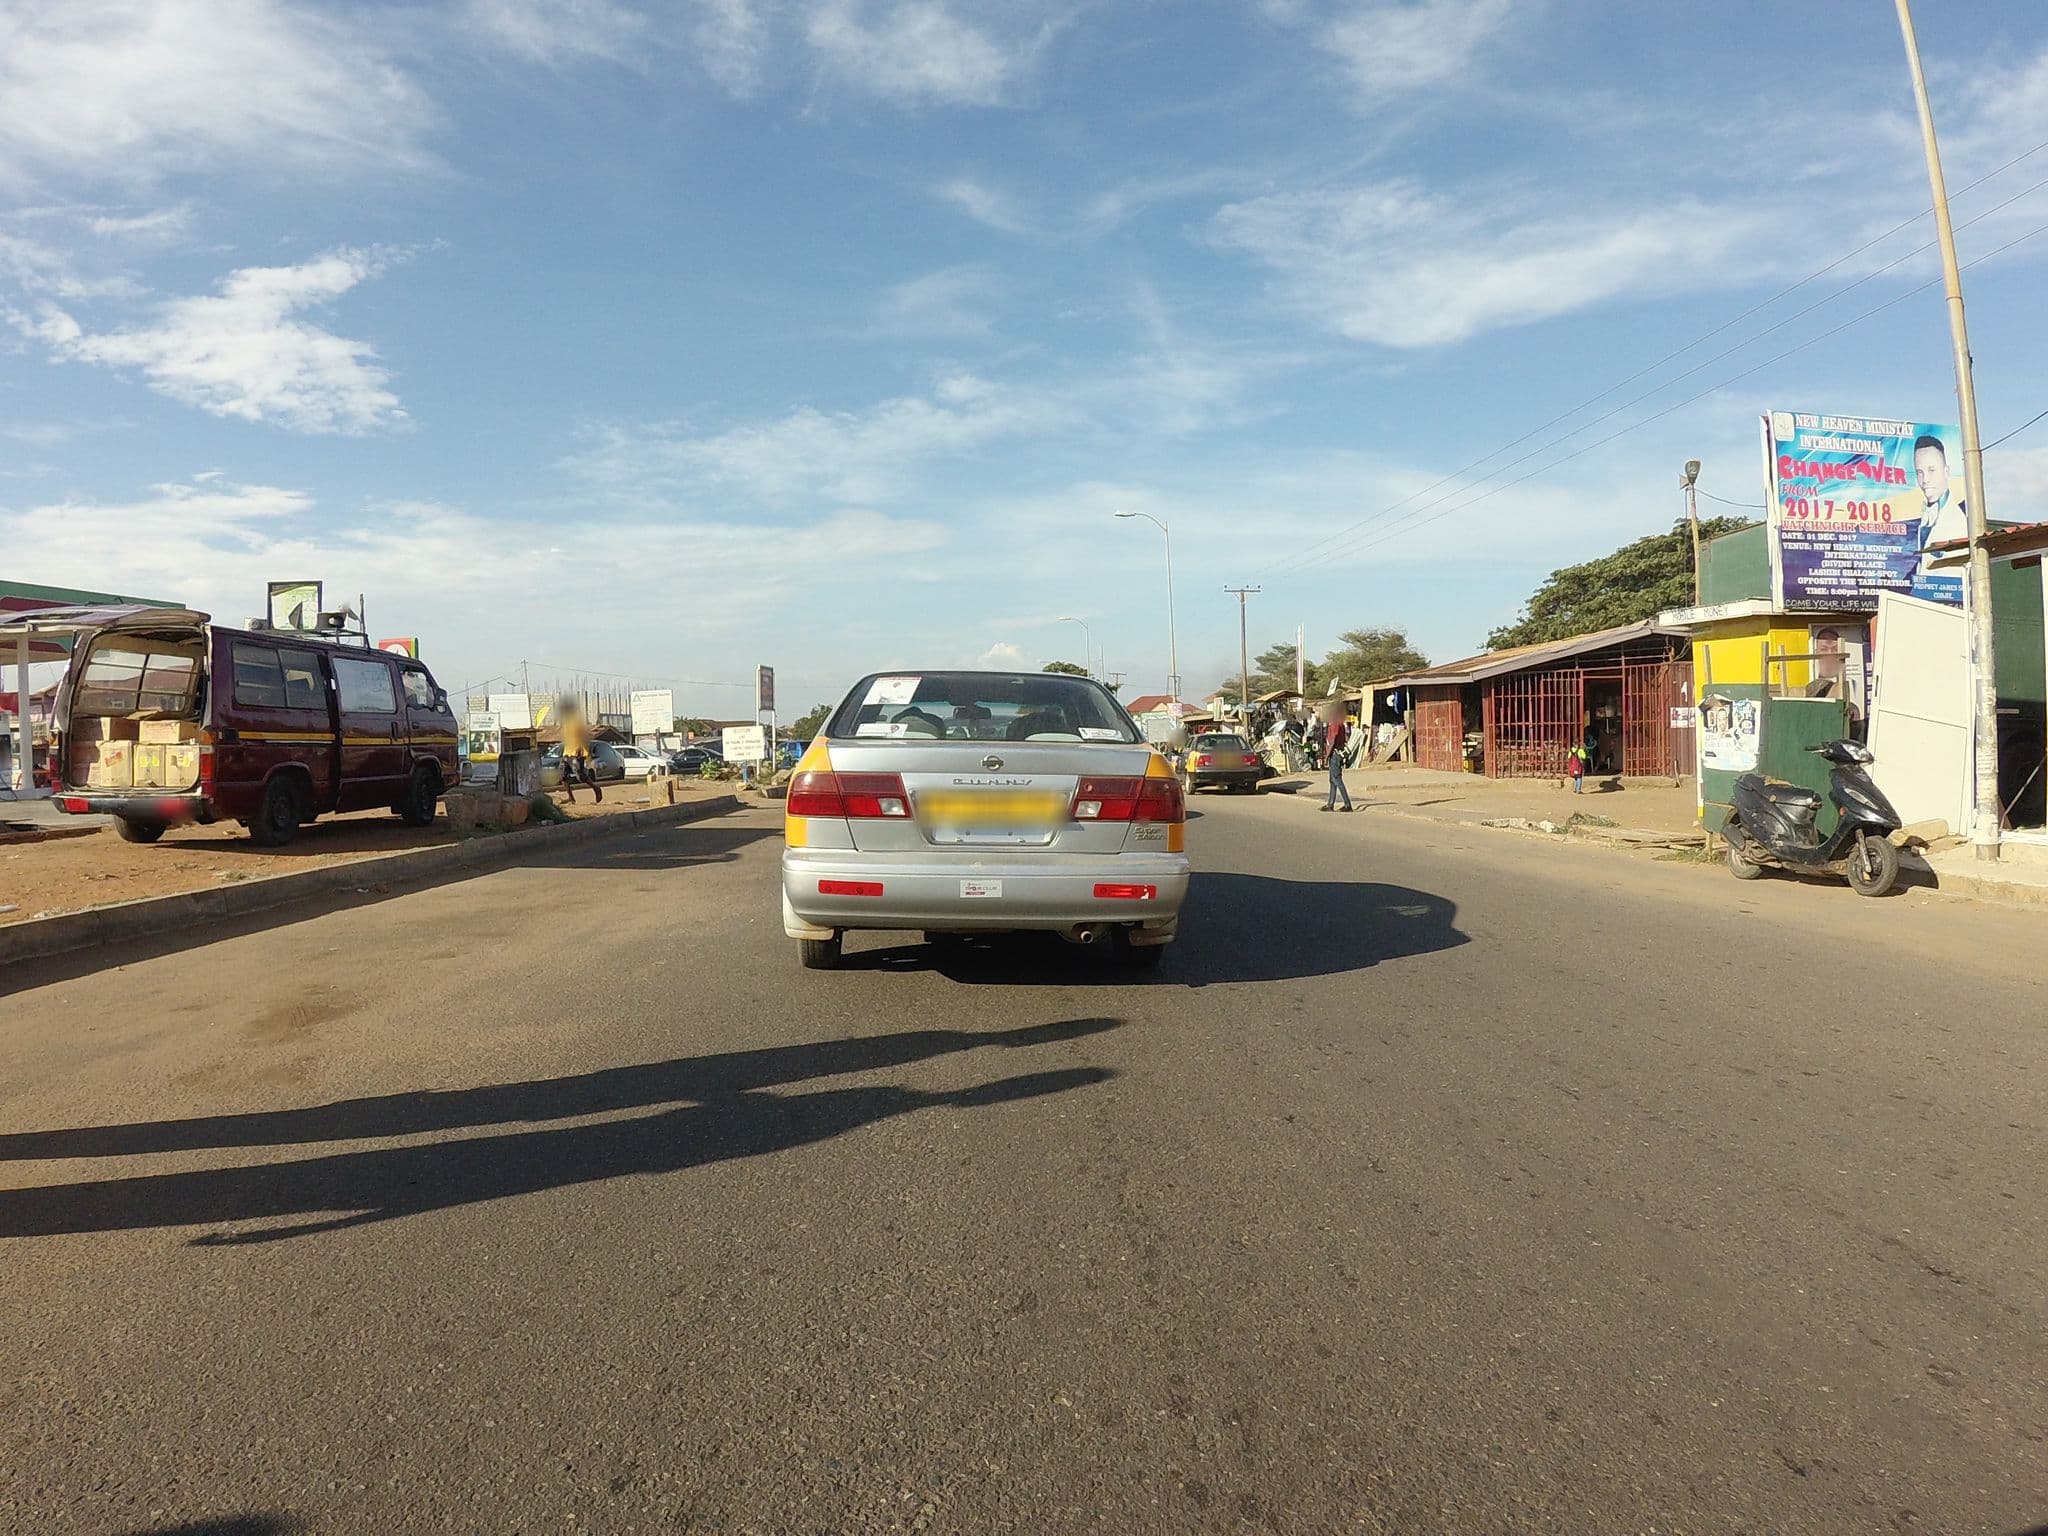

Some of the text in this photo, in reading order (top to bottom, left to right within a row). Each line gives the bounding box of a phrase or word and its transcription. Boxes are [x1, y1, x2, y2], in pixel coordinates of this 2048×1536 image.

[1795, 413, 1915, 436] NEW HEAVEN MINISTRY
[1799, 434, 1885, 454] INTERNATIONAL
[1781, 483, 1819, 497] FROM
[1781, 519, 1907, 536] WATCHNIGHT SERVICE
[1781, 532, 1805, 540] DATE:
[1782, 542, 1903, 553] VENUE: NEW HEAVEN MINISTRY
[1823, 551, 1888, 560] INTERNATIONAL
[1797, 577, 1839, 585] OPPOSITE
[1839, 578, 1857, 586] THE
[1805, 587, 1830, 595] TIME:
[1785, 599, 1811, 608] COME
[1812, 599, 1840, 609] YOUR
[1841, 600, 1860, 608] LIFE
[952, 778, 1033, 786] SUNNY
